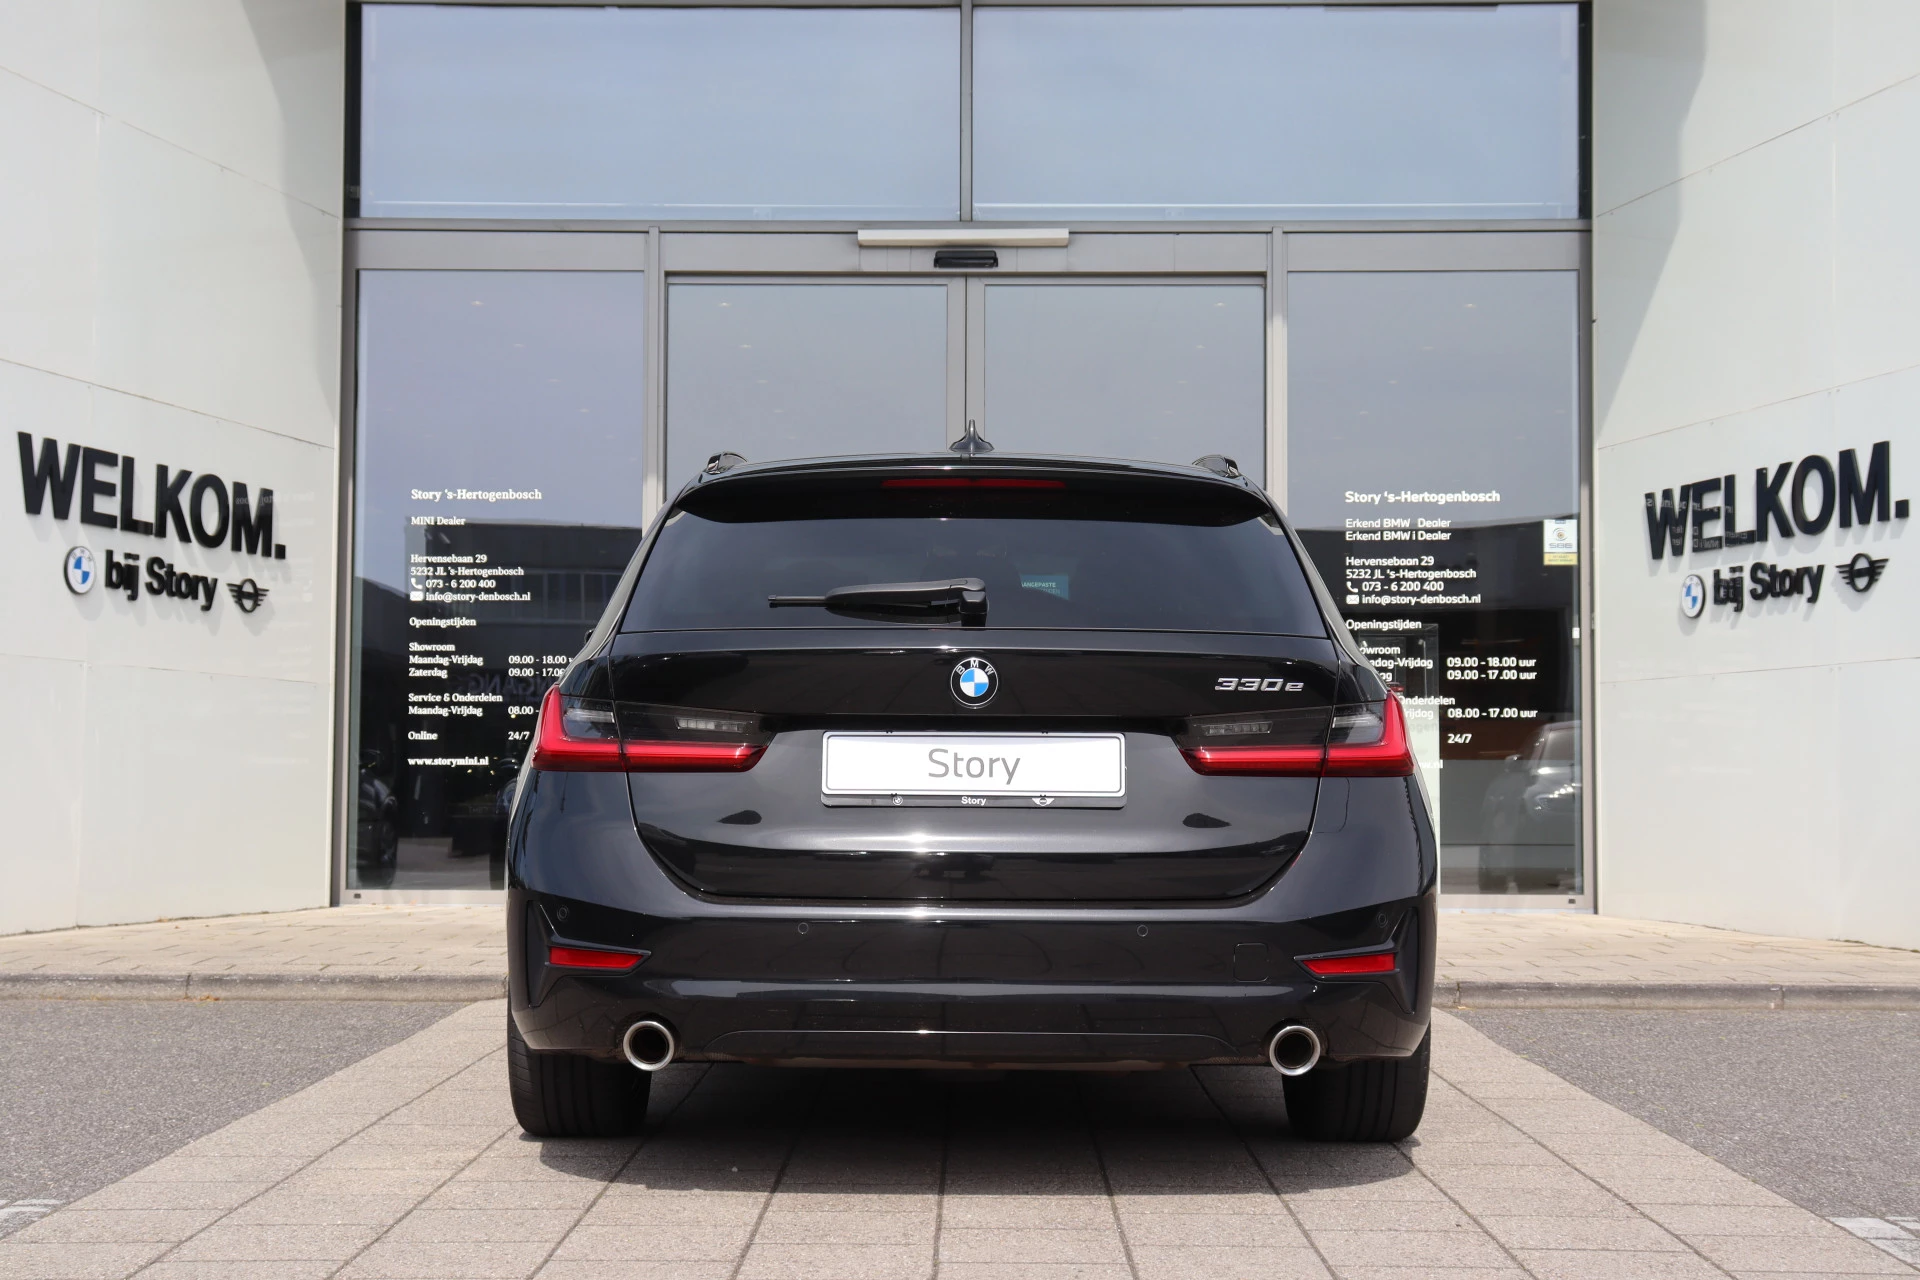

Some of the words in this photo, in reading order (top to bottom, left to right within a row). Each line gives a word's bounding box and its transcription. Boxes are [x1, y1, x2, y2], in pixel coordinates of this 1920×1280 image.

[17, 431, 286, 560] WELKOM.
[411, 489, 442, 502] Story
[1345, 491, 1381, 504] Story
[1645, 440, 1910, 560] WELKOM.
[411, 517, 434, 525] MINI
[436, 517, 466, 525] Dealer
[1346, 518, 1380, 528] Erkend
[1383, 518, 1410, 528] BMW
[1417, 518, 1451, 528] Dealer
[1346, 531, 1380, 541] Erkend
[1383, 531, 1410, 541] BMW
[1418, 531, 1451, 541] Dealer
[411, 554, 473, 563] Hervensebaan
[475, 554, 487, 563] 29
[1346, 556, 1418, 566] Hervensebaan
[1420, 556, 1435, 566] 29
[411, 567, 433, 575] 5232
[435, 567, 447, 575] JL
[1346, 569, 1371, 579] 5232
[1373, 569, 1385, 580] JL
[105, 549, 140, 601] bij
[144, 556, 218, 611] Story
[426, 580, 443, 588] 073
[451, 580, 457, 588] 6
[459, 580, 477, 588] 200
[478, 580, 496, 588] 400
[1750, 562, 1825, 604] Story
[1362, 582, 1381, 591] 073
[1390, 582, 1398, 591] 6
[1400, 582, 1421, 591] 200
[1422, 582, 1444, 591] 400
[426, 592, 531, 602] info@story-denbosch.nl
[1362, 594, 1481, 605] info@story-denbosch.nl
[409, 617, 476, 628] Openingstijden
[1346, 619, 1422, 631] Openingstijden
[409, 642, 455, 651] Showroom
[1360, 646, 1400, 654] owroom
[409, 655, 484, 666] Maandag-Vrijdag
[508, 655, 534, 664] 09.00
[542, 655, 567, 664] 18.00
[1447, 657, 1478, 667] 09.00
[1487, 657, 1517, 667] 18.00
[1518, 659, 1536, 667] uur
[409, 668, 448, 679] Zaterdag
[508, 668, 534, 677] 09.00
[1447, 670, 1478, 680] 09.00
[1519, 672, 1537, 680] uur
[1215, 678, 1304, 691] 330e
[408, 693, 441, 702] Service
[443, 693, 450, 702] &
[452, 693, 503, 702] Onderdelen
[408, 706, 483, 716] Maandag-Vrijdag
[508, 706, 533, 715] 08.00
[1447, 708, 1479, 718] 08.00
[1520, 710, 1538, 718] uur
[408, 731, 438, 740] Online
[508, 732, 529, 740] 24/7
[1447, 734, 1472, 744] 24/7
[408, 756, 489, 767] www.storymini.nl
[928, 748, 1021, 785] Story
[961, 796, 987, 806] Story
